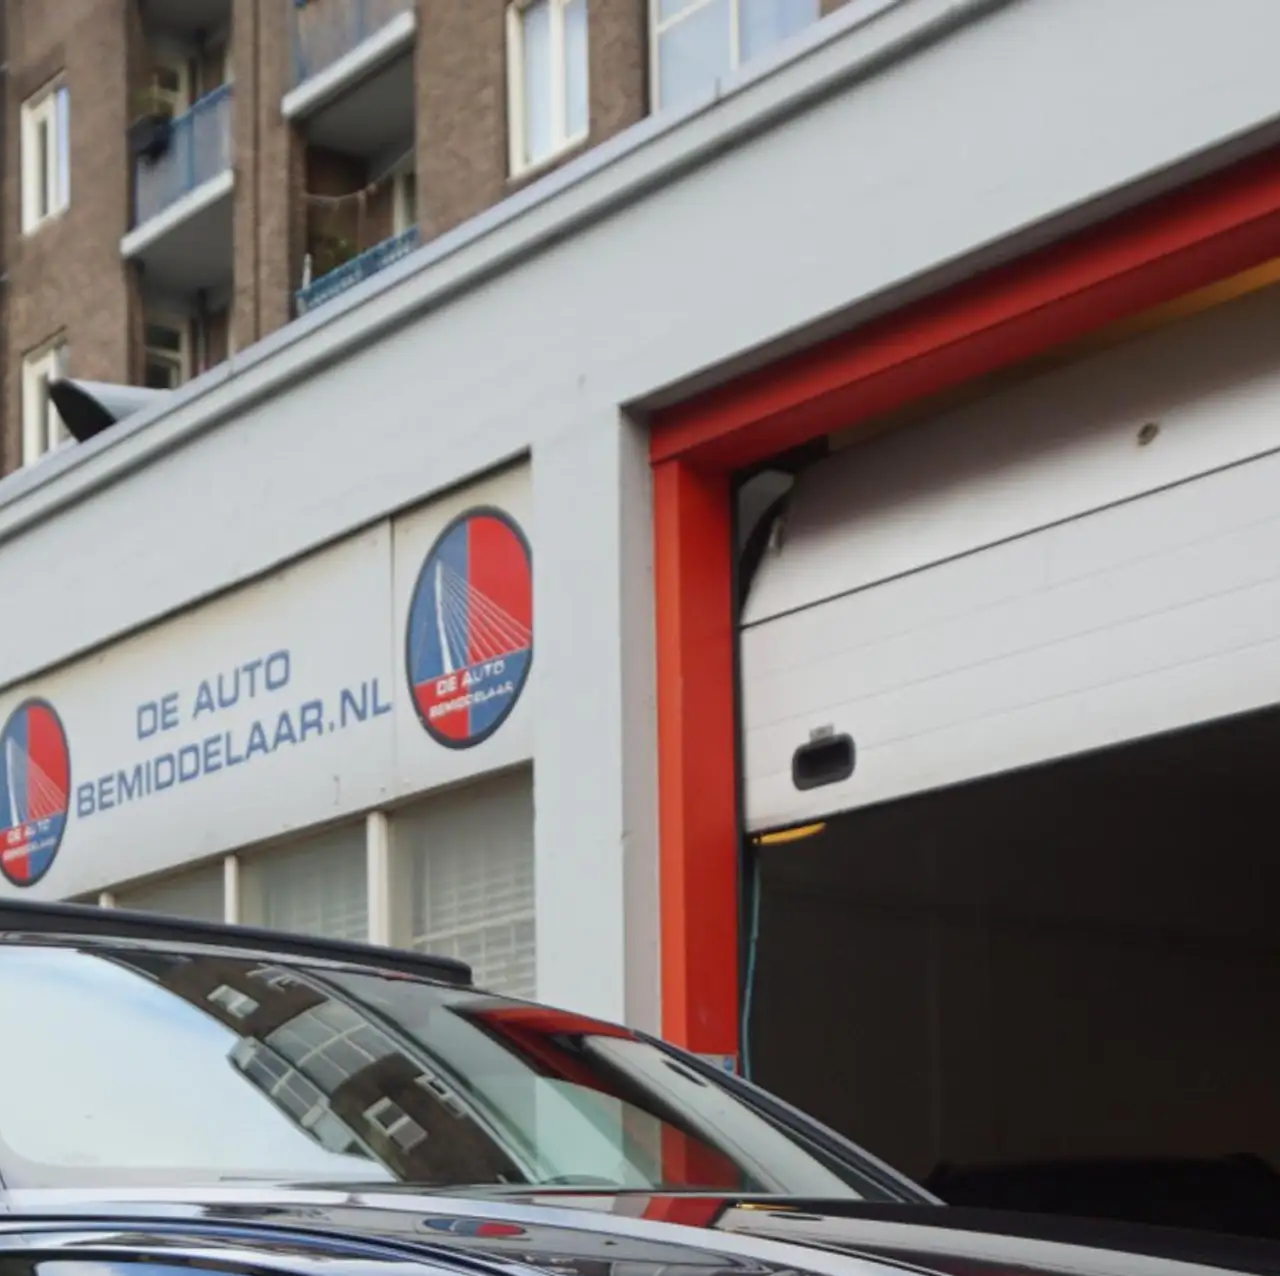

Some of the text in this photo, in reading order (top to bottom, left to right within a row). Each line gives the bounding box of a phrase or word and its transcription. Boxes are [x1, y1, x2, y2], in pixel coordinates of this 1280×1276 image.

[136, 649, 291, 741] DE AUTO
[435, 661, 505, 697] DE AUTO
[76, 678, 392, 818] BEMIDDELAAR.NL
